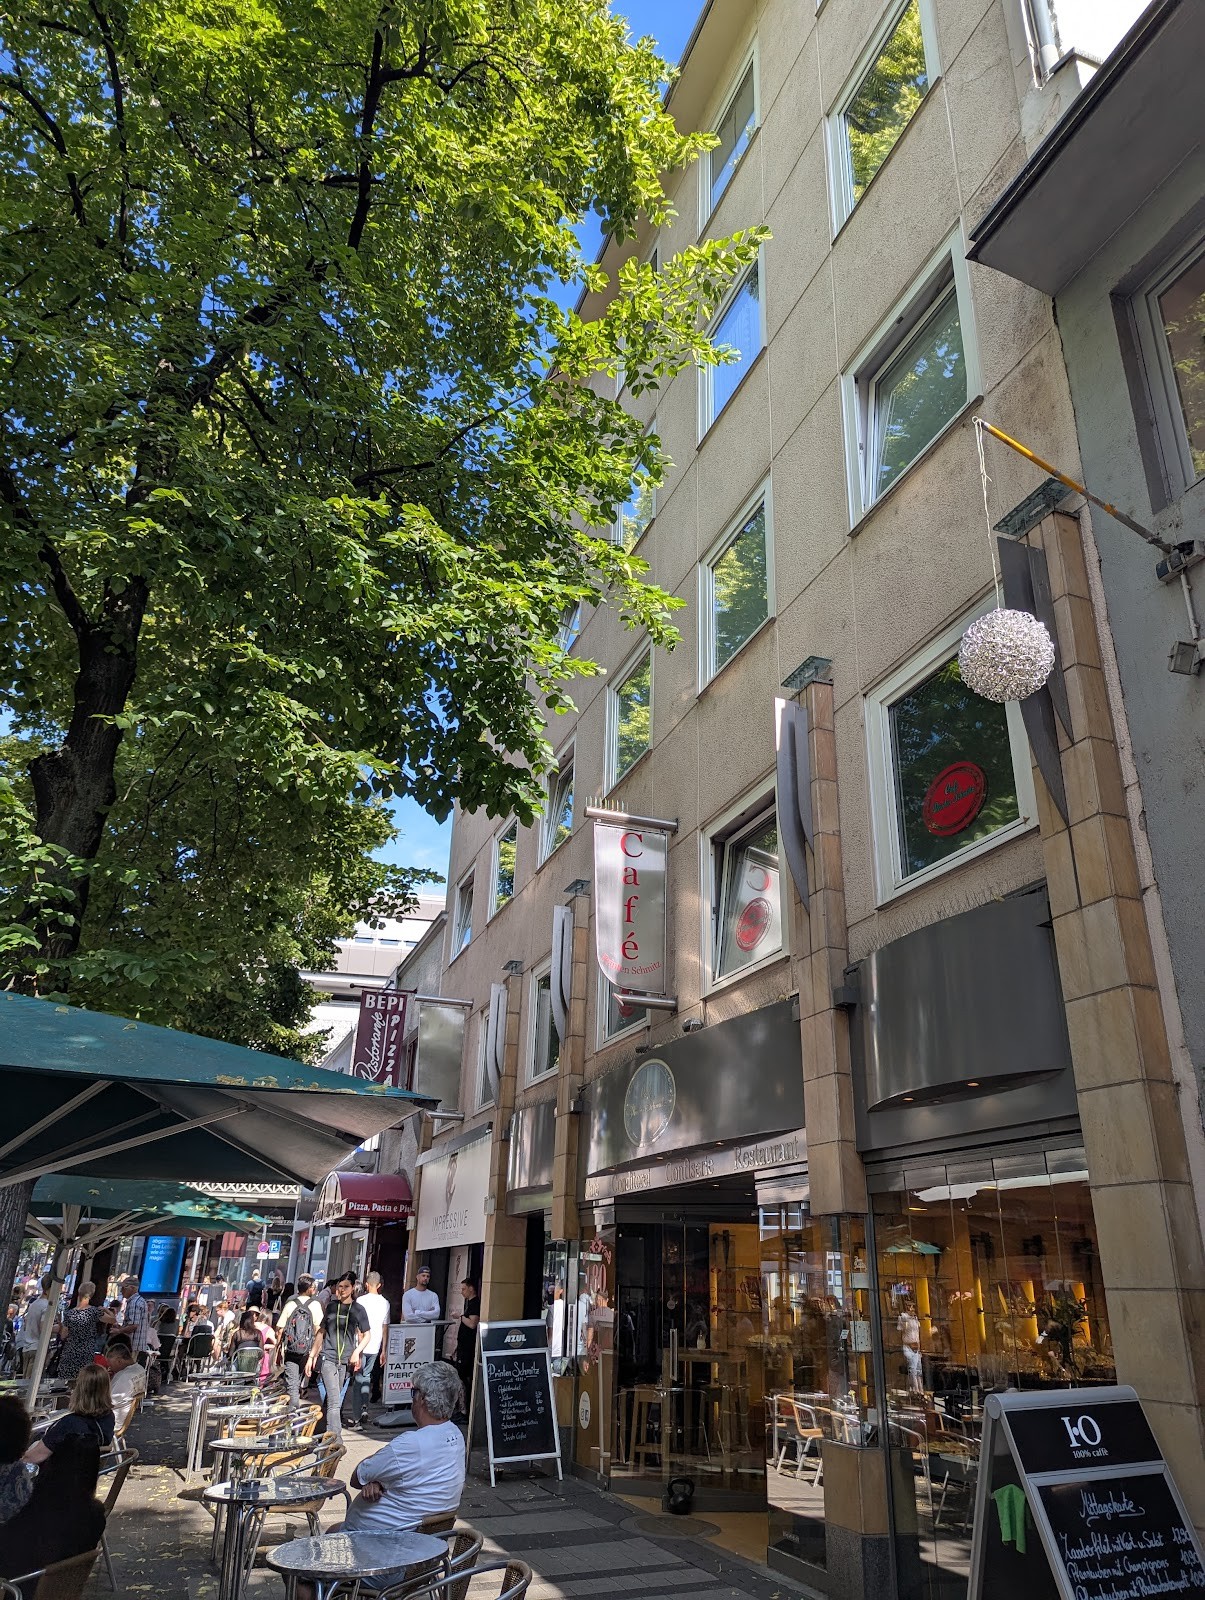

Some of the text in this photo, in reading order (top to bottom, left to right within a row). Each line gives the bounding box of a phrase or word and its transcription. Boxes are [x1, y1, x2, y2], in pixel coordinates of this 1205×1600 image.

[620, 832, 643, 960] Café
[631, 961, 662, 975] Schmitz
[365, 994, 404, 1011] BEPI
[384, 1014, 400, 1087] PIZZA
[733, 1136, 800, 1170] Restaurant
[348, 1202, 370, 1211] Pizza,
[372, 1202, 392, 1212] Pasta
[432, 1209, 468, 1231] IMPRESSIVE
[503, 1334, 527, 1343] AZUL
[1073, 1449, 1091, 1459] 100%
[1079, 1488, 1136, 1520] Mittagskarte
